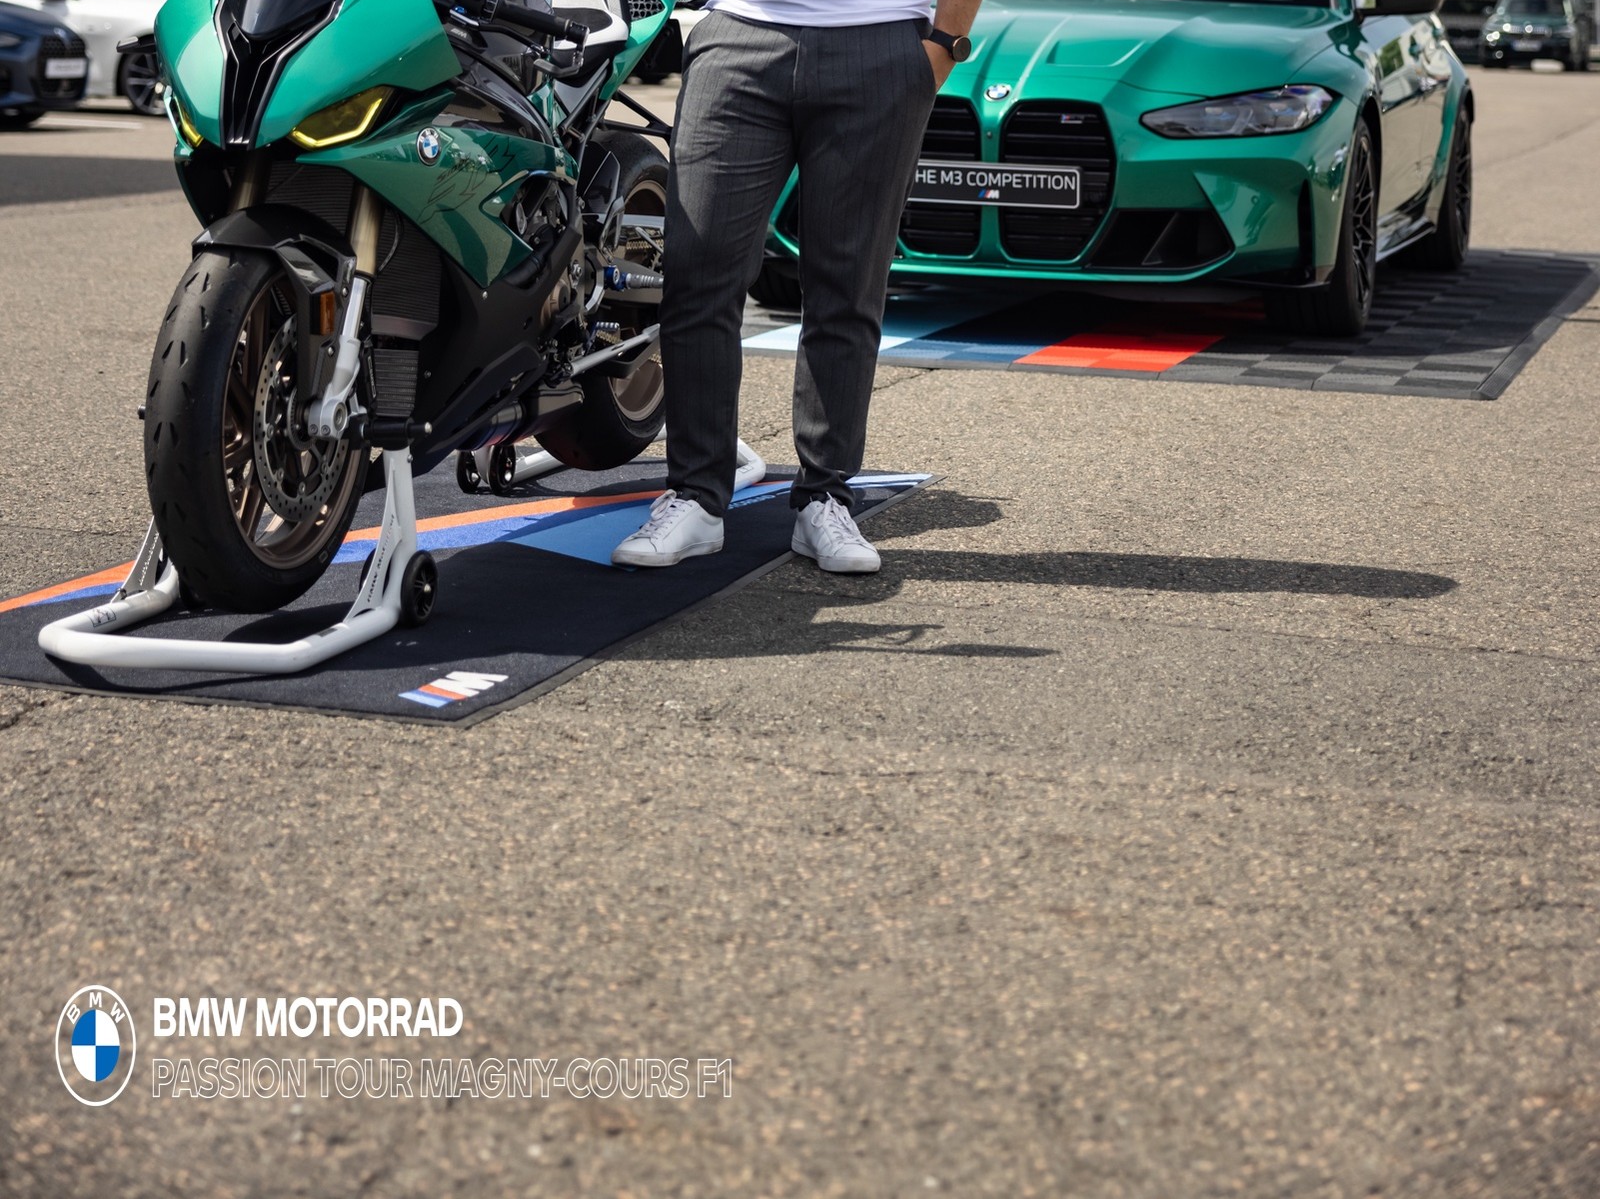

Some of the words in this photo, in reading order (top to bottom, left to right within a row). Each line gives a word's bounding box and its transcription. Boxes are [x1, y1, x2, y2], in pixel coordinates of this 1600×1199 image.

[915, 169, 937, 184] HE
[940, 171, 963, 186] M3
[966, 171, 1076, 191] COMPETITION
